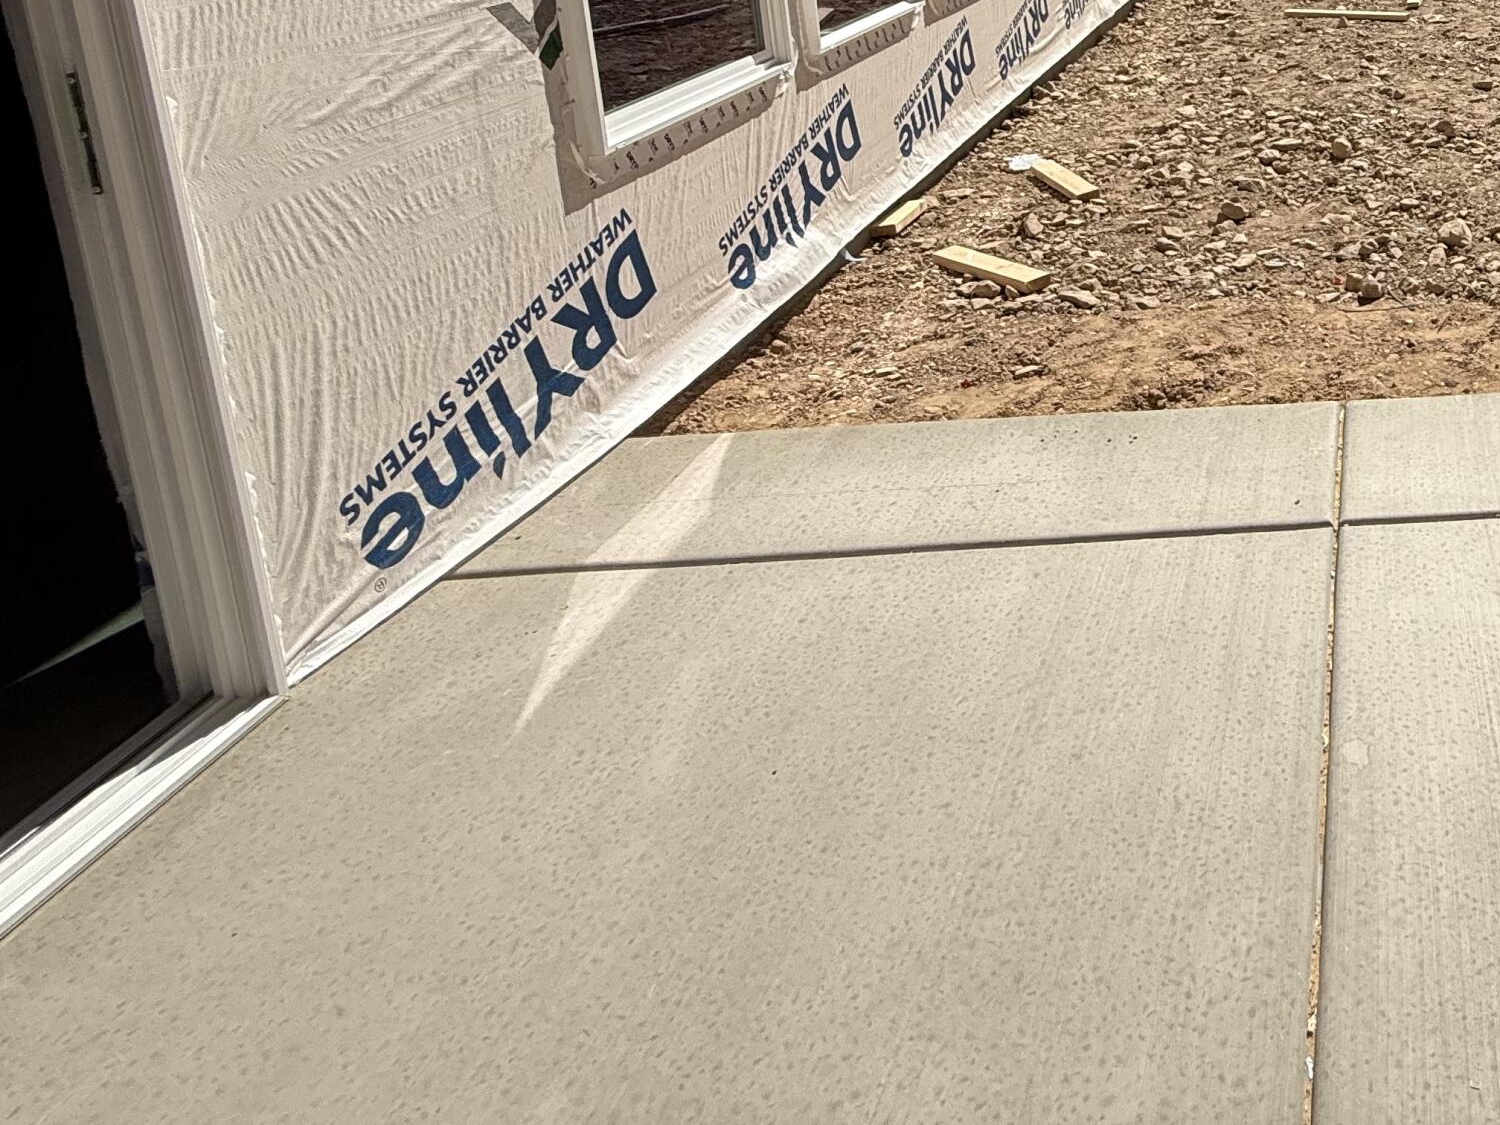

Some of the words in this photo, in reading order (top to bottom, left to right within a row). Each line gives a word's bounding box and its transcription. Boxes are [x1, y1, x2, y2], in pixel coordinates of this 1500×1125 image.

[920, 48, 945, 89] BARRIER
[943, 15, 968, 55] WEATHER
[809, 83, 850, 139] WEATHER
[894, 84, 921, 130] SYSTEMS
[899, 29, 976, 158] DRYline
[728, 99, 861, 289] DRYline
[768, 131, 809, 192] BARRIER
[546, 208, 633, 303] WEATHER
[719, 185, 768, 256] SYSTEMS
[456, 300, 547, 398] BARRIER
[361, 229, 658, 569] DRYline
[340, 391, 458, 526] SYSTEMS
